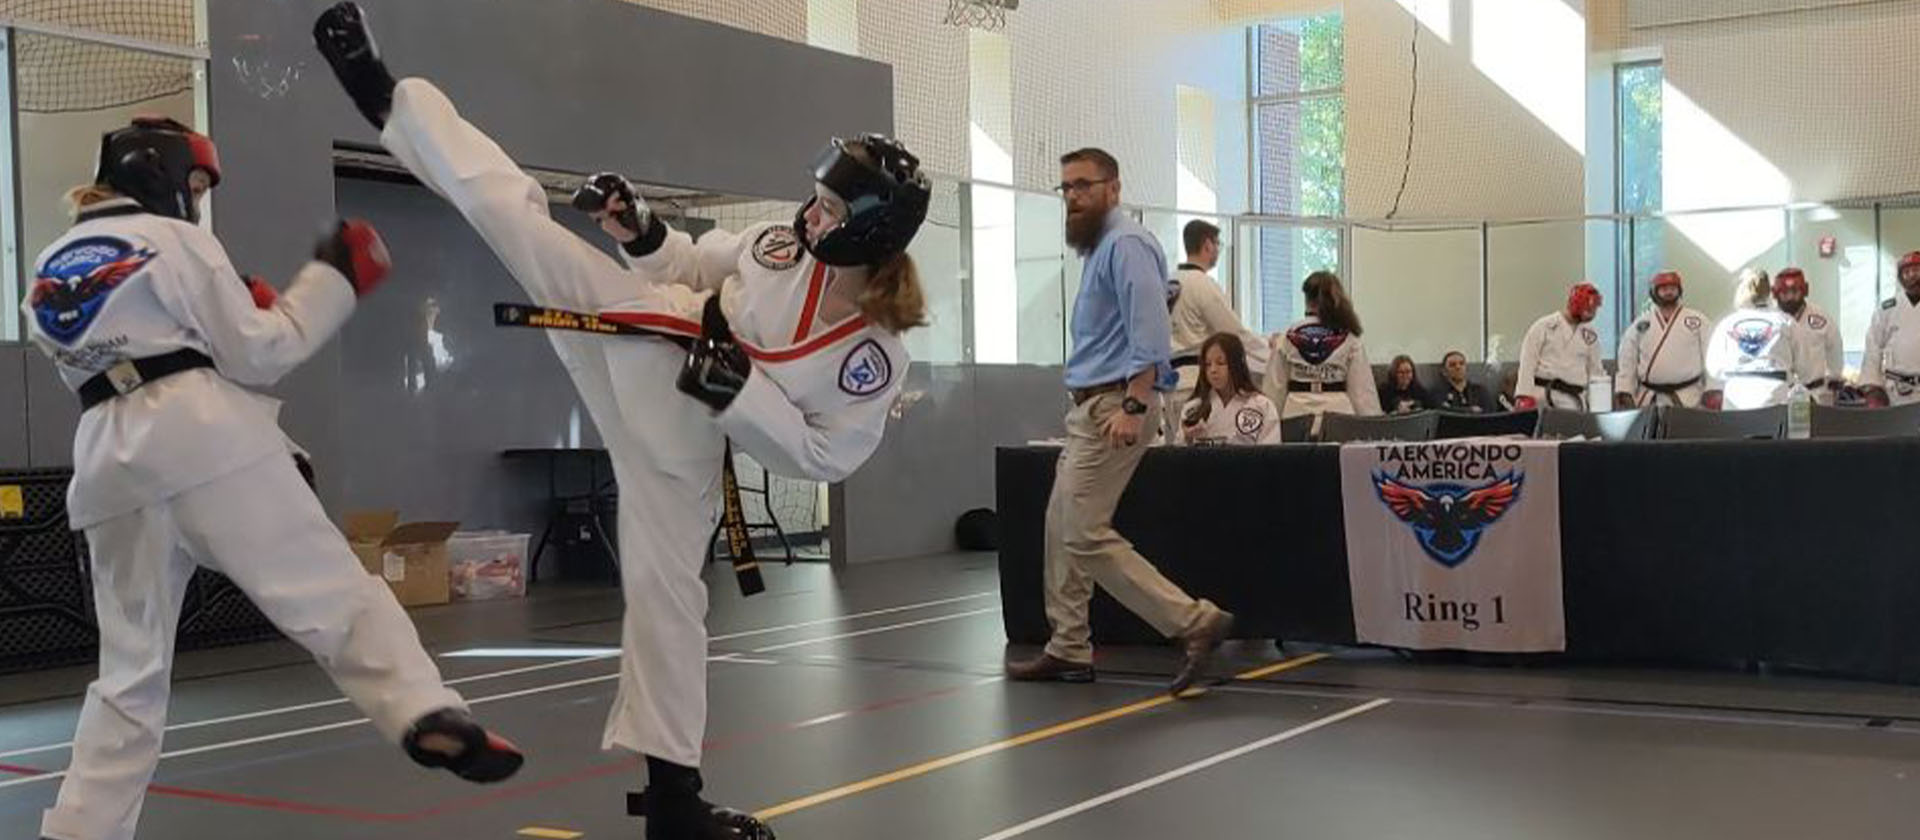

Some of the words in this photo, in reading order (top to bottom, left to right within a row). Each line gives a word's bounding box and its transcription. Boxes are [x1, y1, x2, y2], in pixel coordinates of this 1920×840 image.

[1377, 444, 1521, 462] TAEKWONDO
[1396, 461, 1498, 480] AMERICA
[1404, 592, 1479, 629] Ring
[1493, 595, 1505, 623] 1
